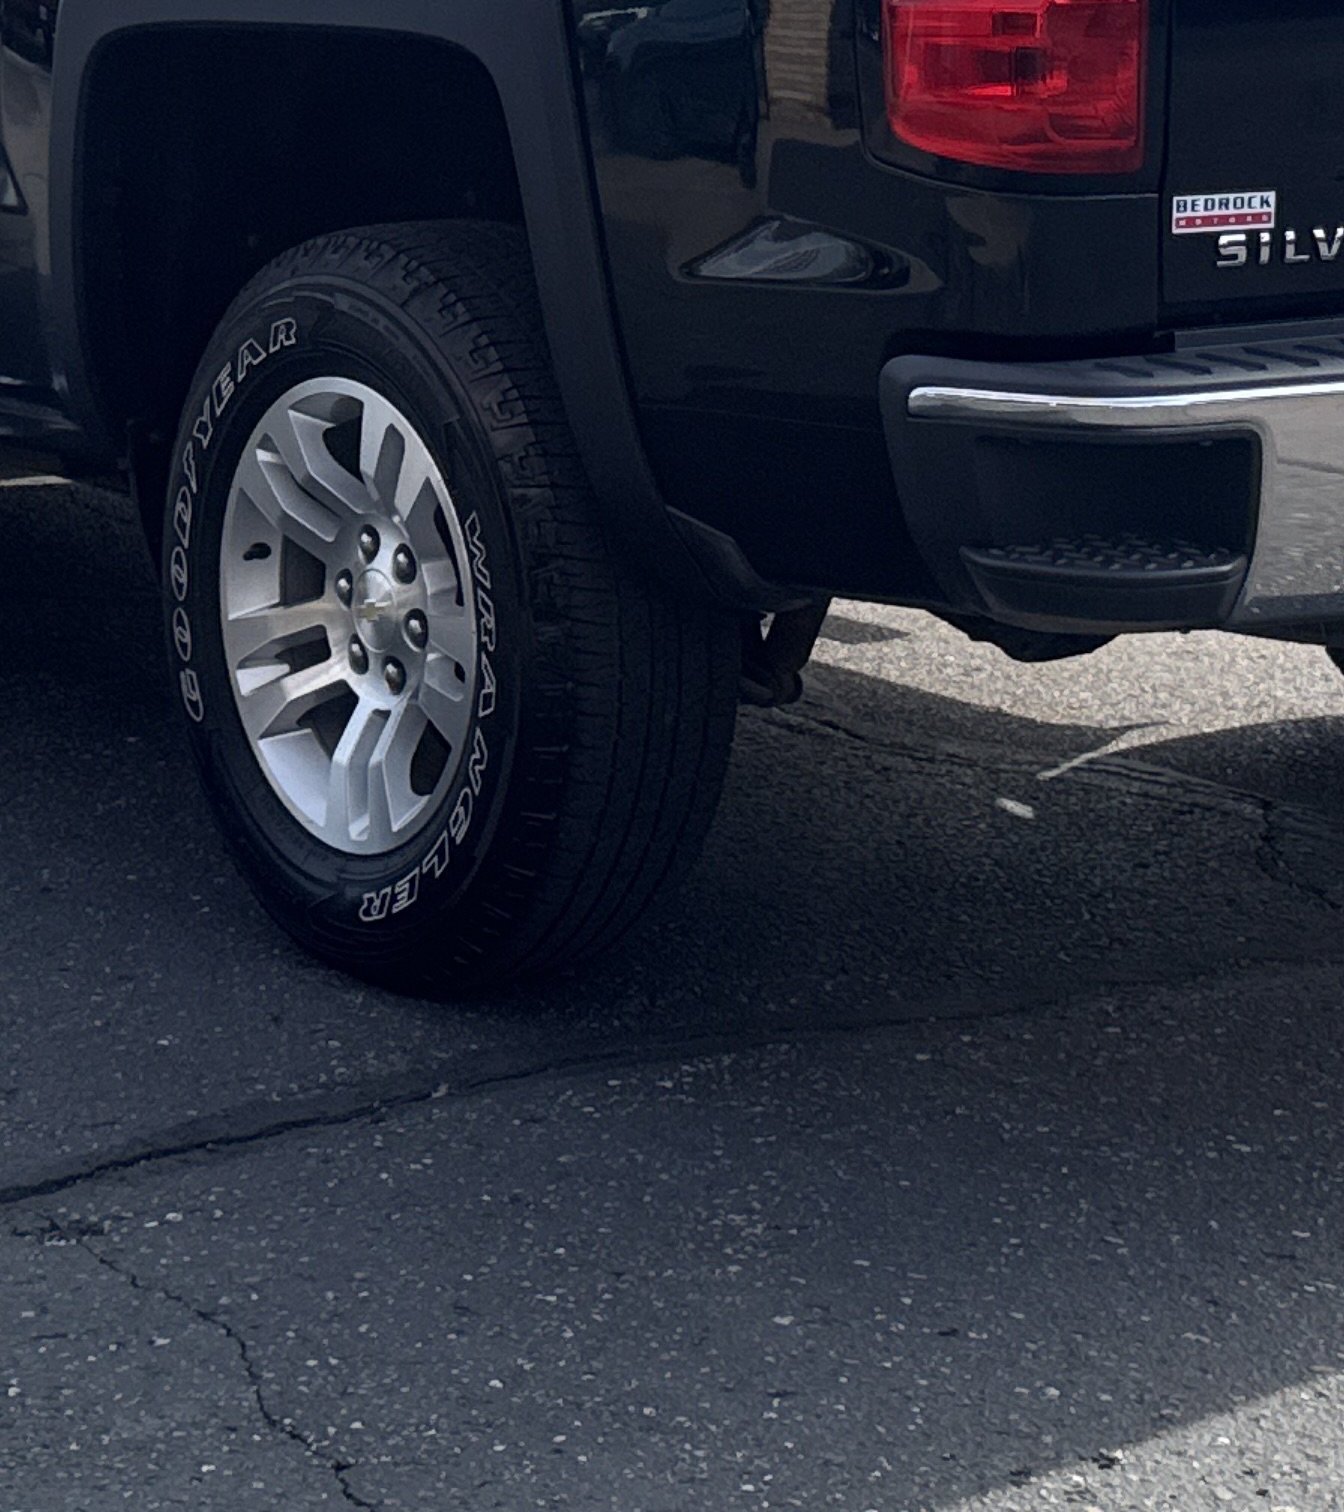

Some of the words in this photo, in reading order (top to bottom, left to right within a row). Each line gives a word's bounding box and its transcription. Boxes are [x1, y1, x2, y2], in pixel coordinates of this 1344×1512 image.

[1176, 195, 1271, 213] BEDROCK
[171, 317, 297, 723] GOODYEAR
[359, 511, 496, 922] WRANGLER
